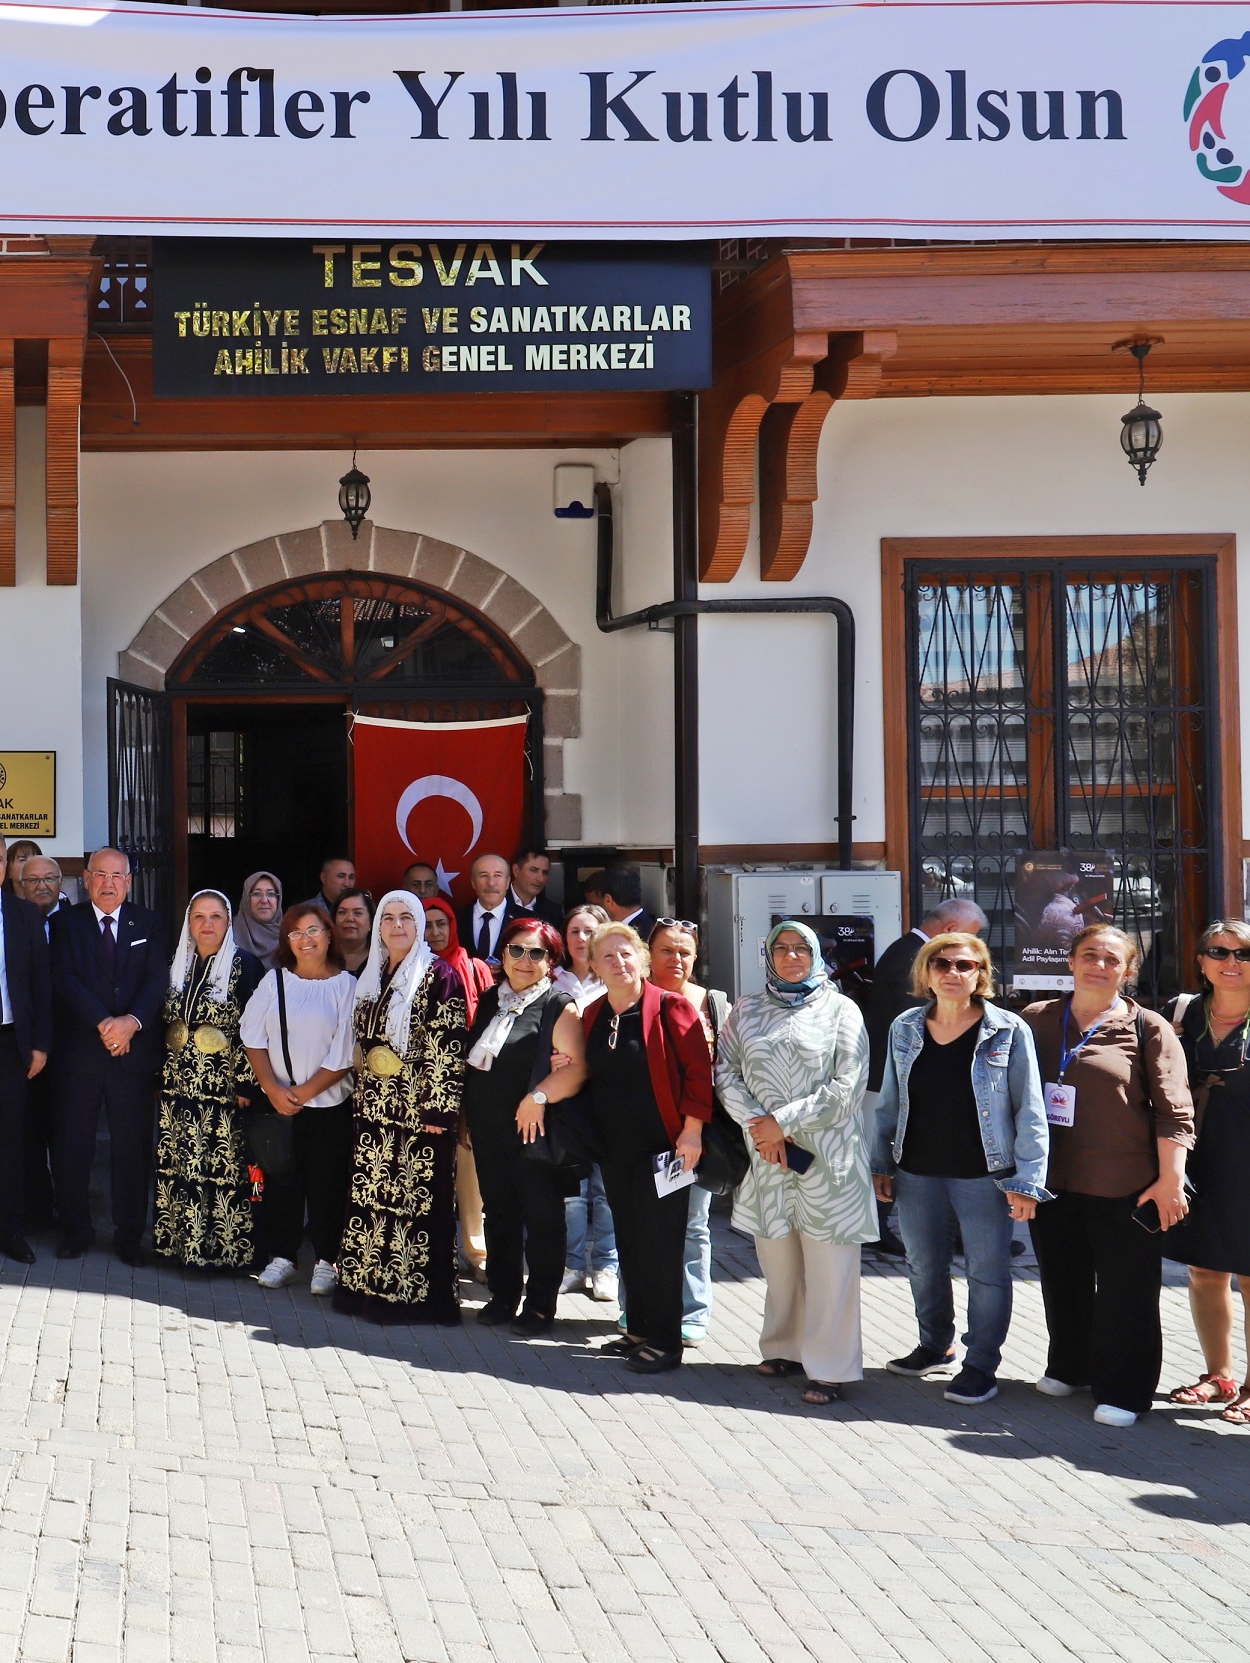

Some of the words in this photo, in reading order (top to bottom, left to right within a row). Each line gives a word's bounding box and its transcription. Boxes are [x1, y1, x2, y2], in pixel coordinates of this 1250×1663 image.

[393, 70, 552, 141] Yılı
[579, 70, 834, 142] Kutlu
[865, 69, 1128, 142] Olsun
[312, 243, 549, 288] TESVAK
[174, 302, 300, 337] TÜRKİYE
[312, 308, 407, 336] ESNAF
[422, 307, 458, 335] VE
[469, 304, 692, 334] SANATKARLAR
[213, 341, 310, 376] AHİLİK
[323, 347, 409, 374] VAKFI
[422, 344, 514, 373] GENEL
[525, 335, 654, 371] MERKEZİ
[10, 821, 40, 829] MERKEZİ
